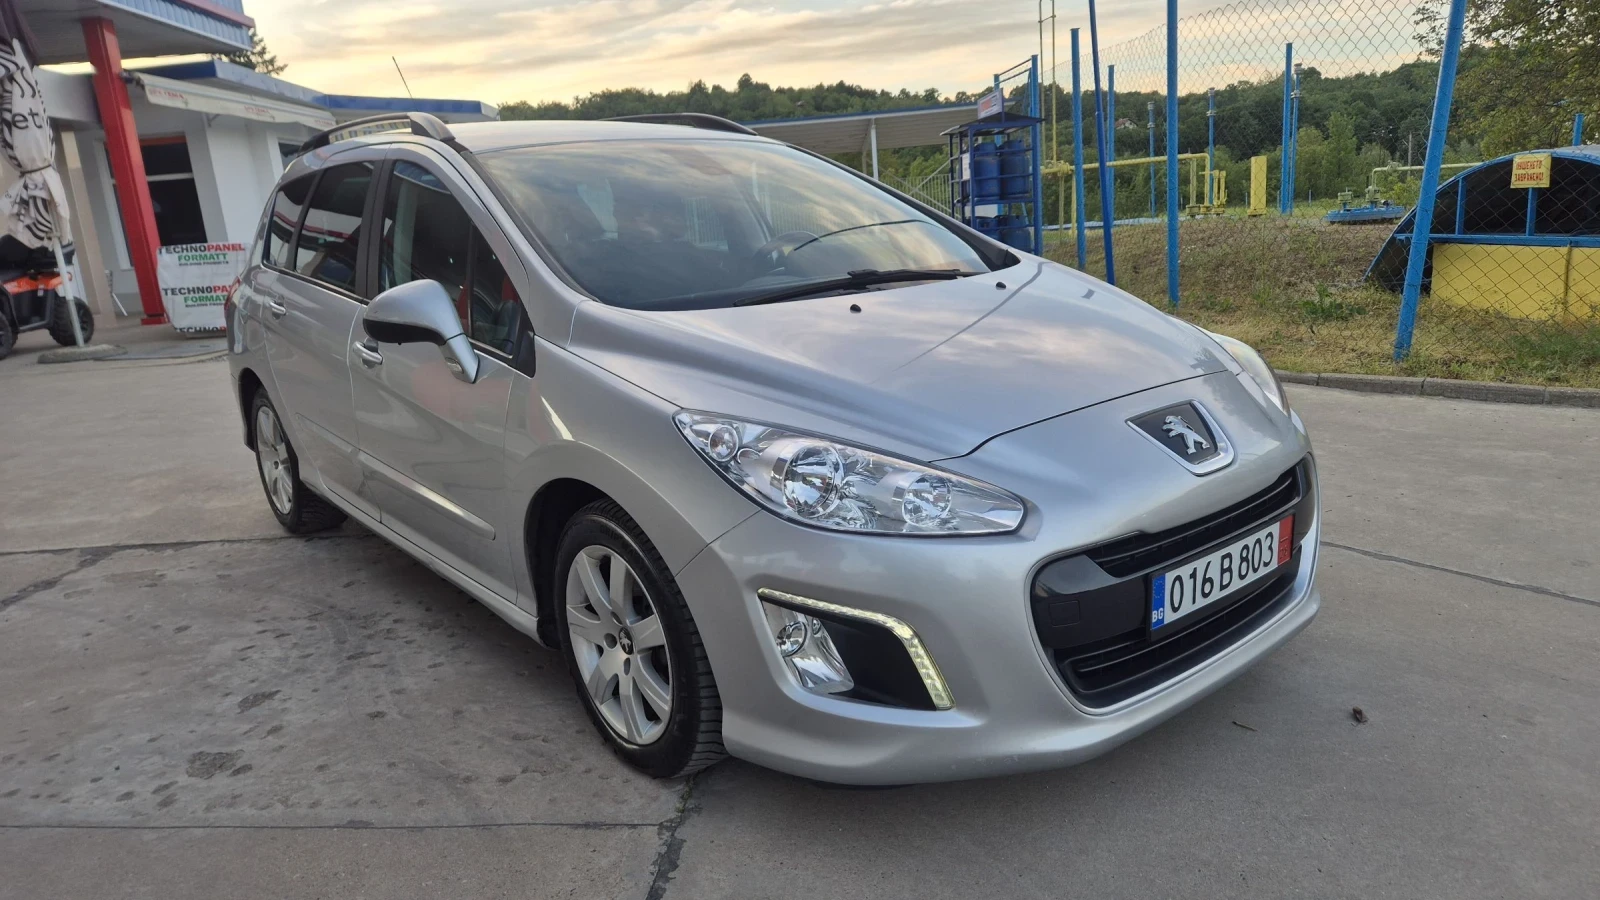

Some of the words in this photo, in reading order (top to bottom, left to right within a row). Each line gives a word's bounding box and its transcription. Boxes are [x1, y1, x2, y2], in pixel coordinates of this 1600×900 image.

[178, 253, 228, 262] FORMATT
[162, 285, 232, 296] TECHNOPA
[184, 294, 228, 303] FORMAT
[1152, 607, 1164, 623] BG
